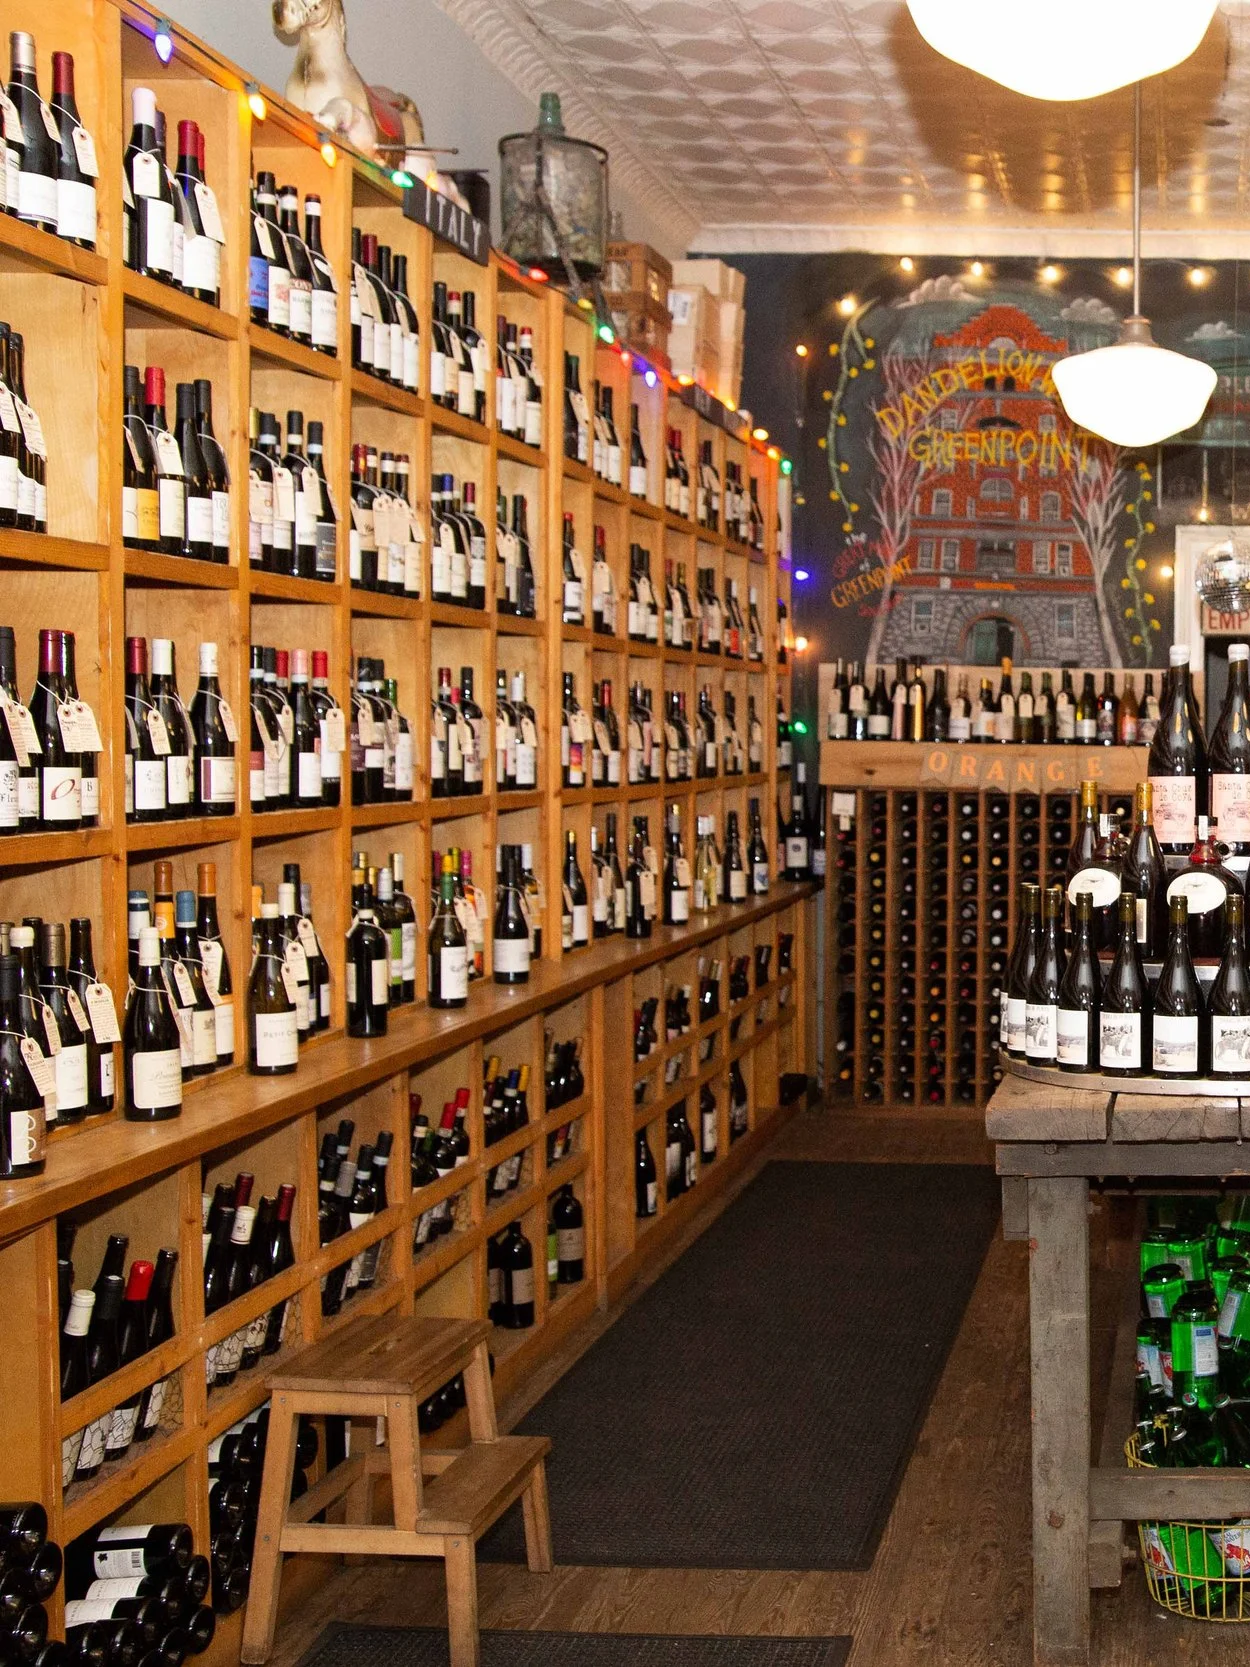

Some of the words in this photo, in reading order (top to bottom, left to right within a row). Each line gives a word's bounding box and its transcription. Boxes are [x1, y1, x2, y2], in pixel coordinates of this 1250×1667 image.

[425, 186, 481, 257] ITALY
[876, 348, 1043, 439] DANDELION
[908, 428, 1101, 473] GREENPOINT
[928, 750, 1104, 783] ORANGE
